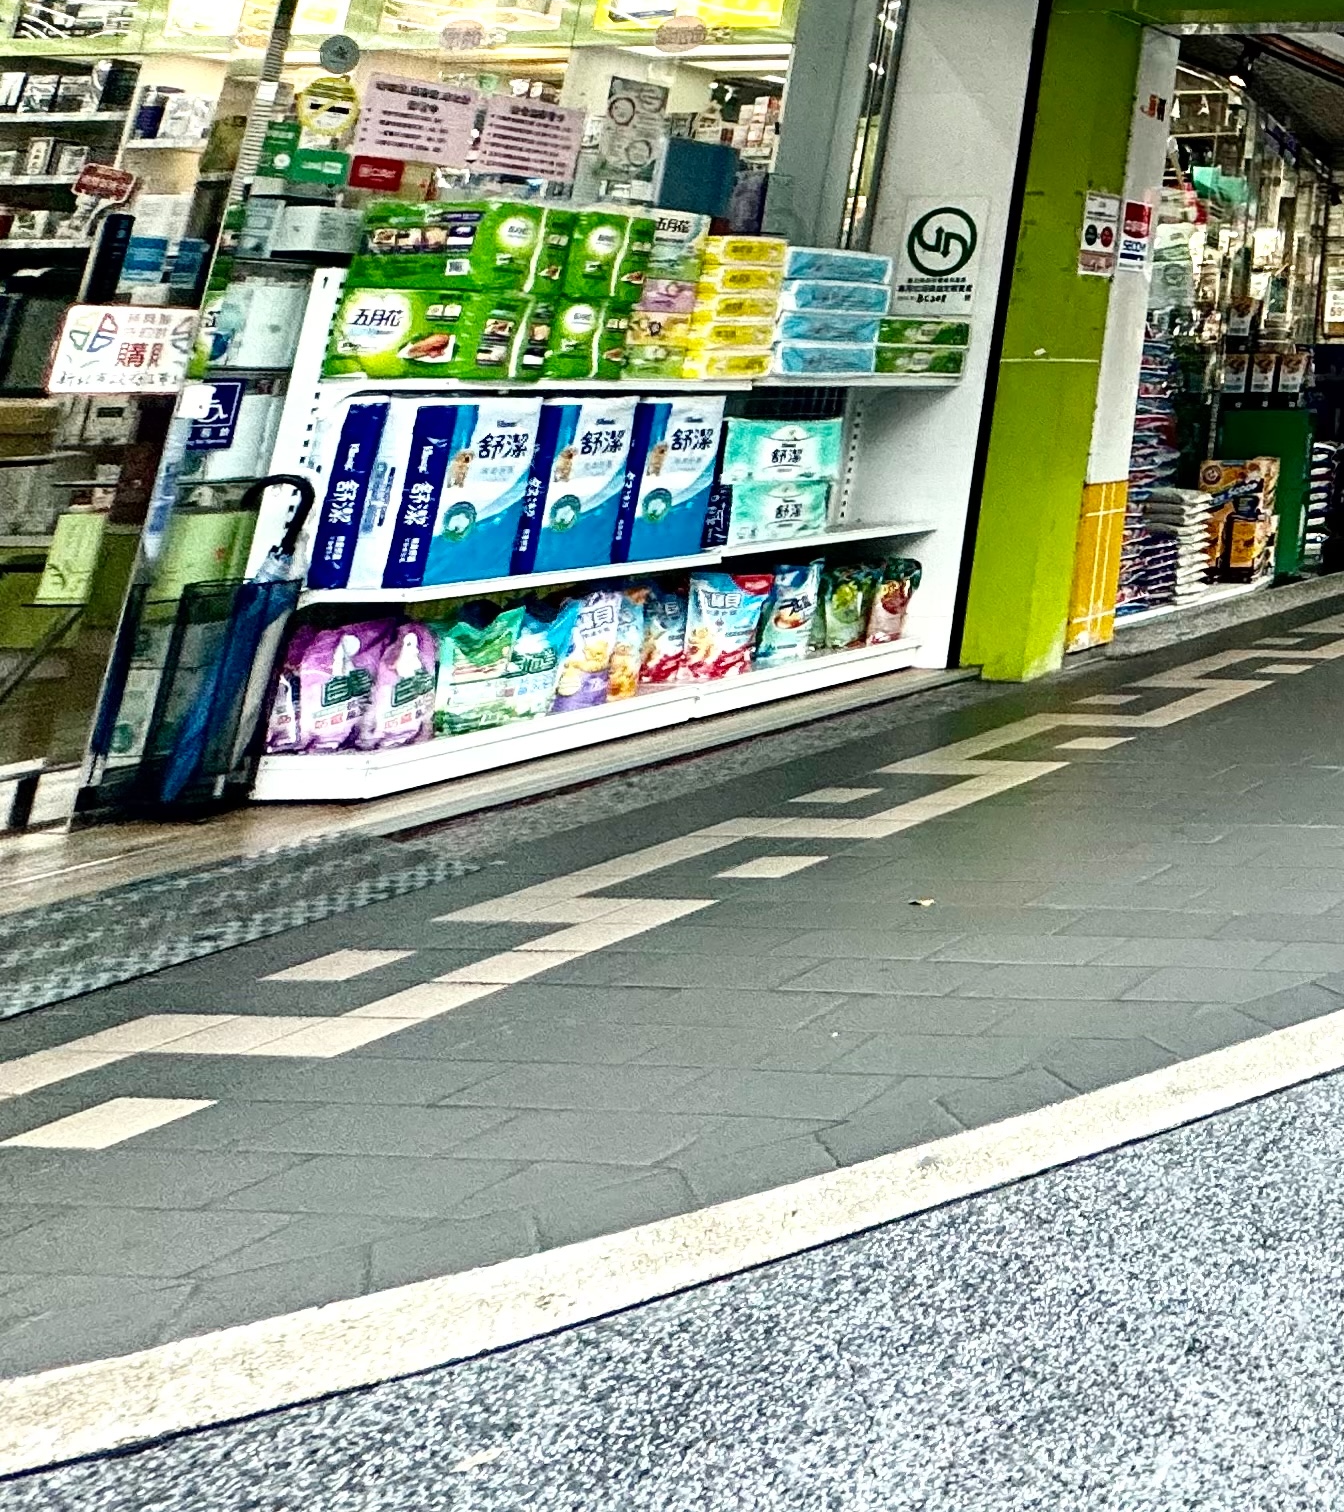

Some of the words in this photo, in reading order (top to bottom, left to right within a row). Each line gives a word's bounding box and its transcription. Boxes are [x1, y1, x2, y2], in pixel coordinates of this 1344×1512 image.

[351, 308, 404, 327] 五月花
[478, 432, 529, 460] 舒潔
[580, 430, 625, 455] 舒潔
[671, 428, 714, 452] 舒潔
